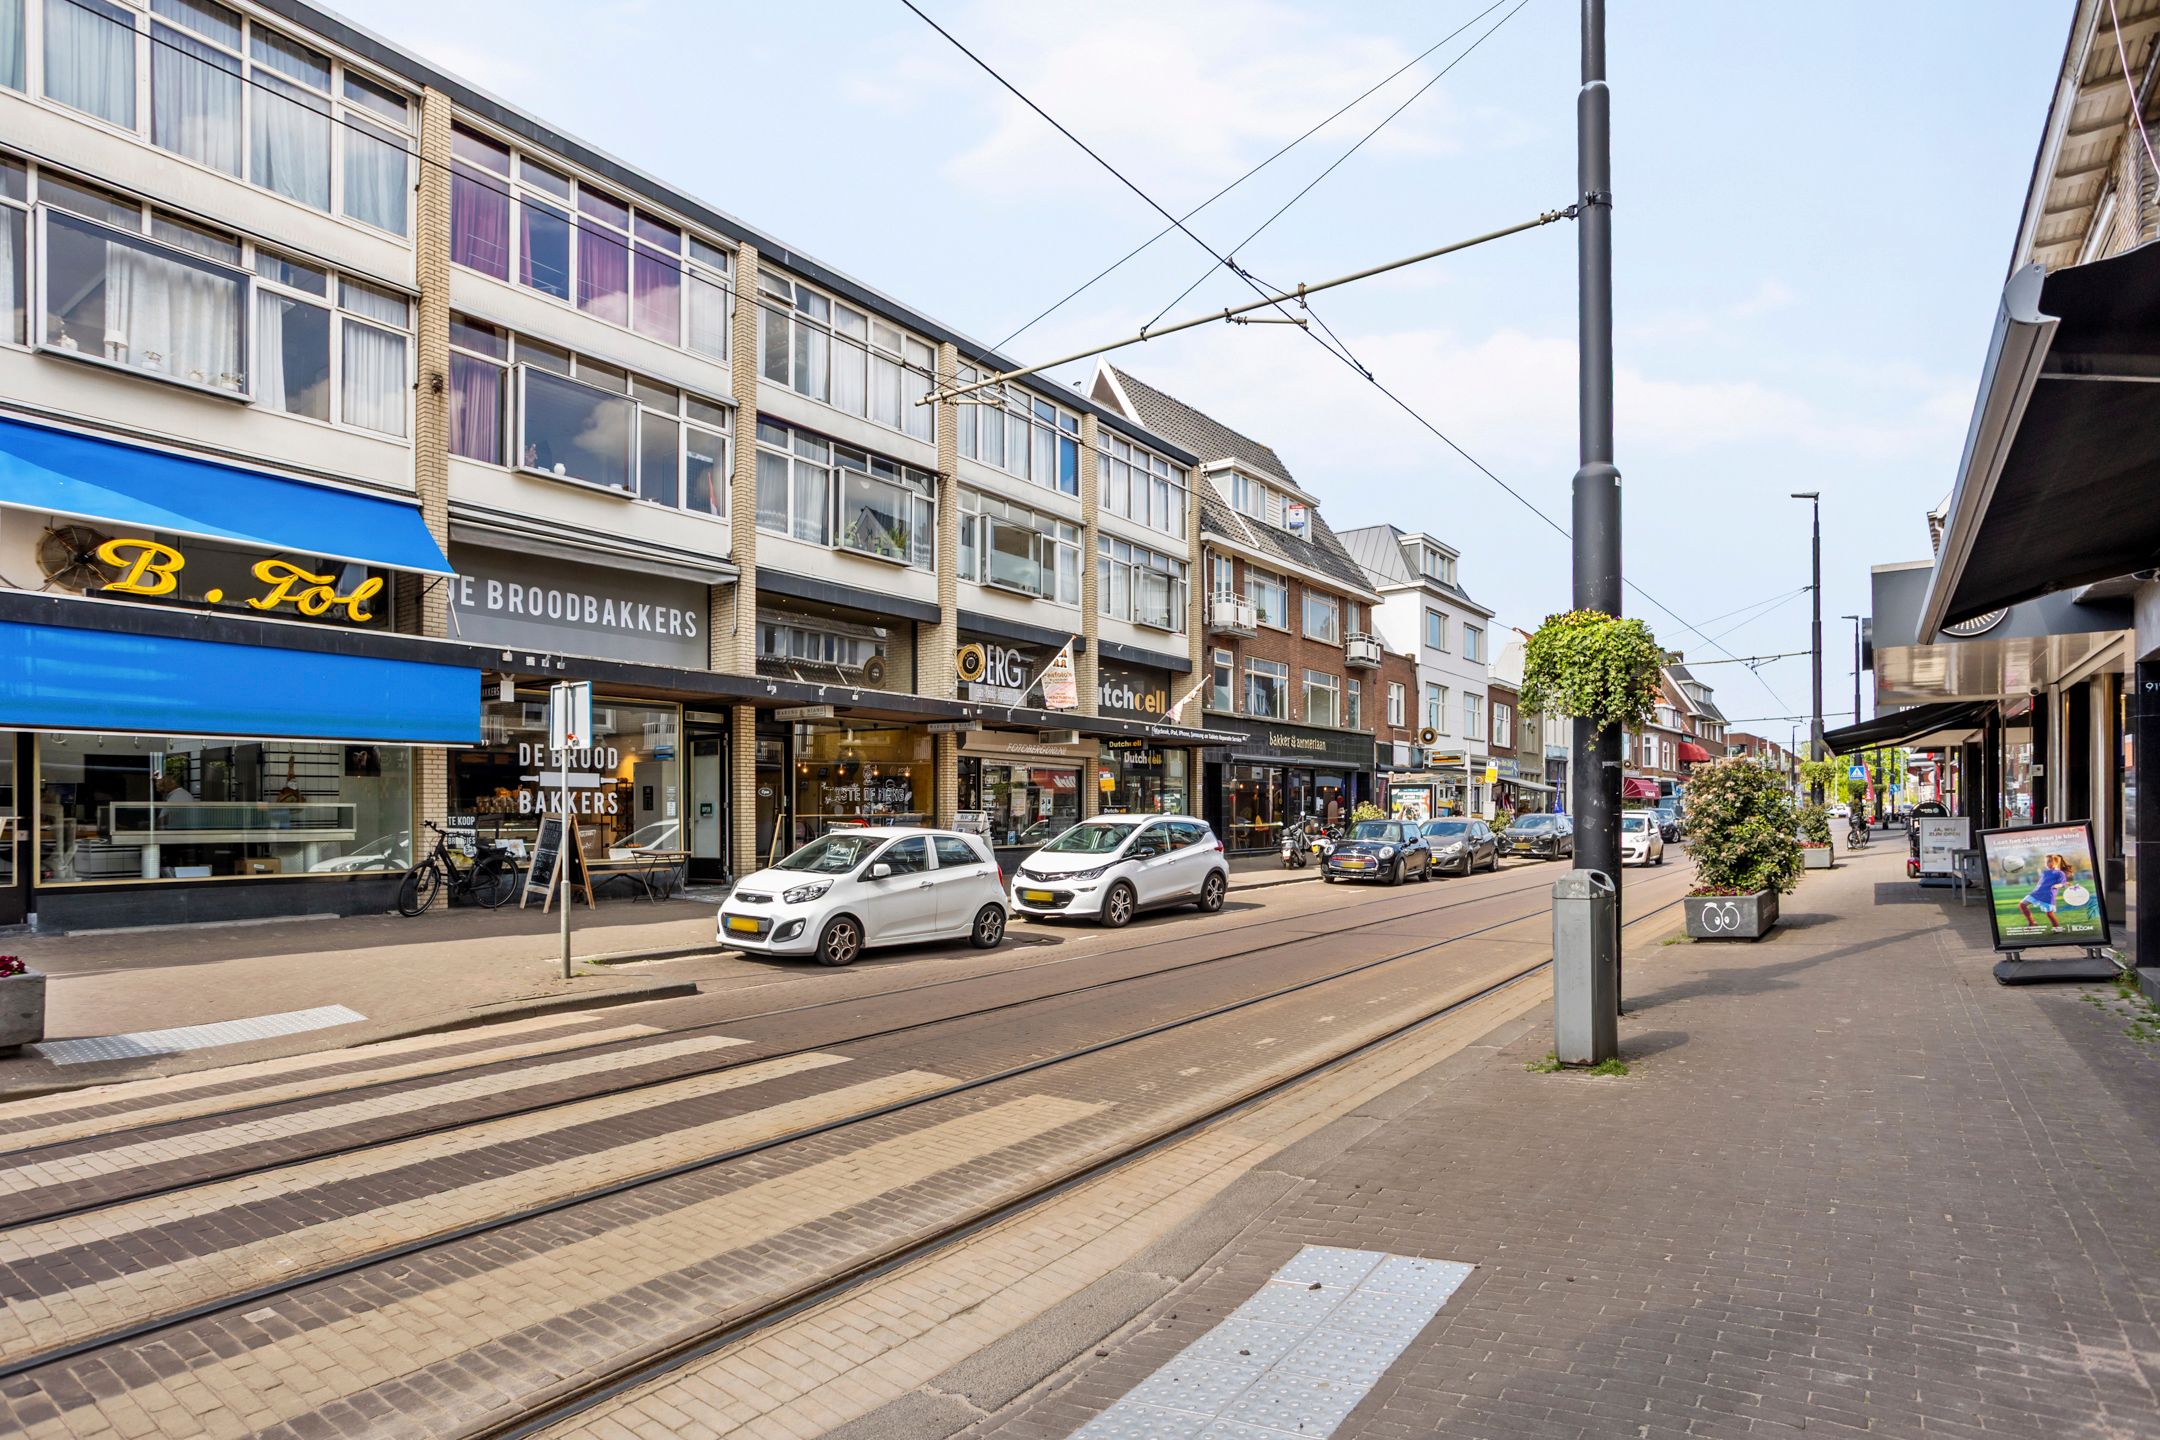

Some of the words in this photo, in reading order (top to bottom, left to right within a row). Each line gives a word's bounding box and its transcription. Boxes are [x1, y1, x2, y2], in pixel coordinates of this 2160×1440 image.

[246, 559, 384, 622] Tol
[487, 579, 697, 638] BROODBAKKERS
[1269, 731, 1290, 747] bakker
[519, 742, 545, 767] DE
[551, 747, 618, 769] BROOD
[519, 790, 618, 815] BAKKERS
[448, 816, 456, 826] TE
[457, 815, 476, 826] KOOP
